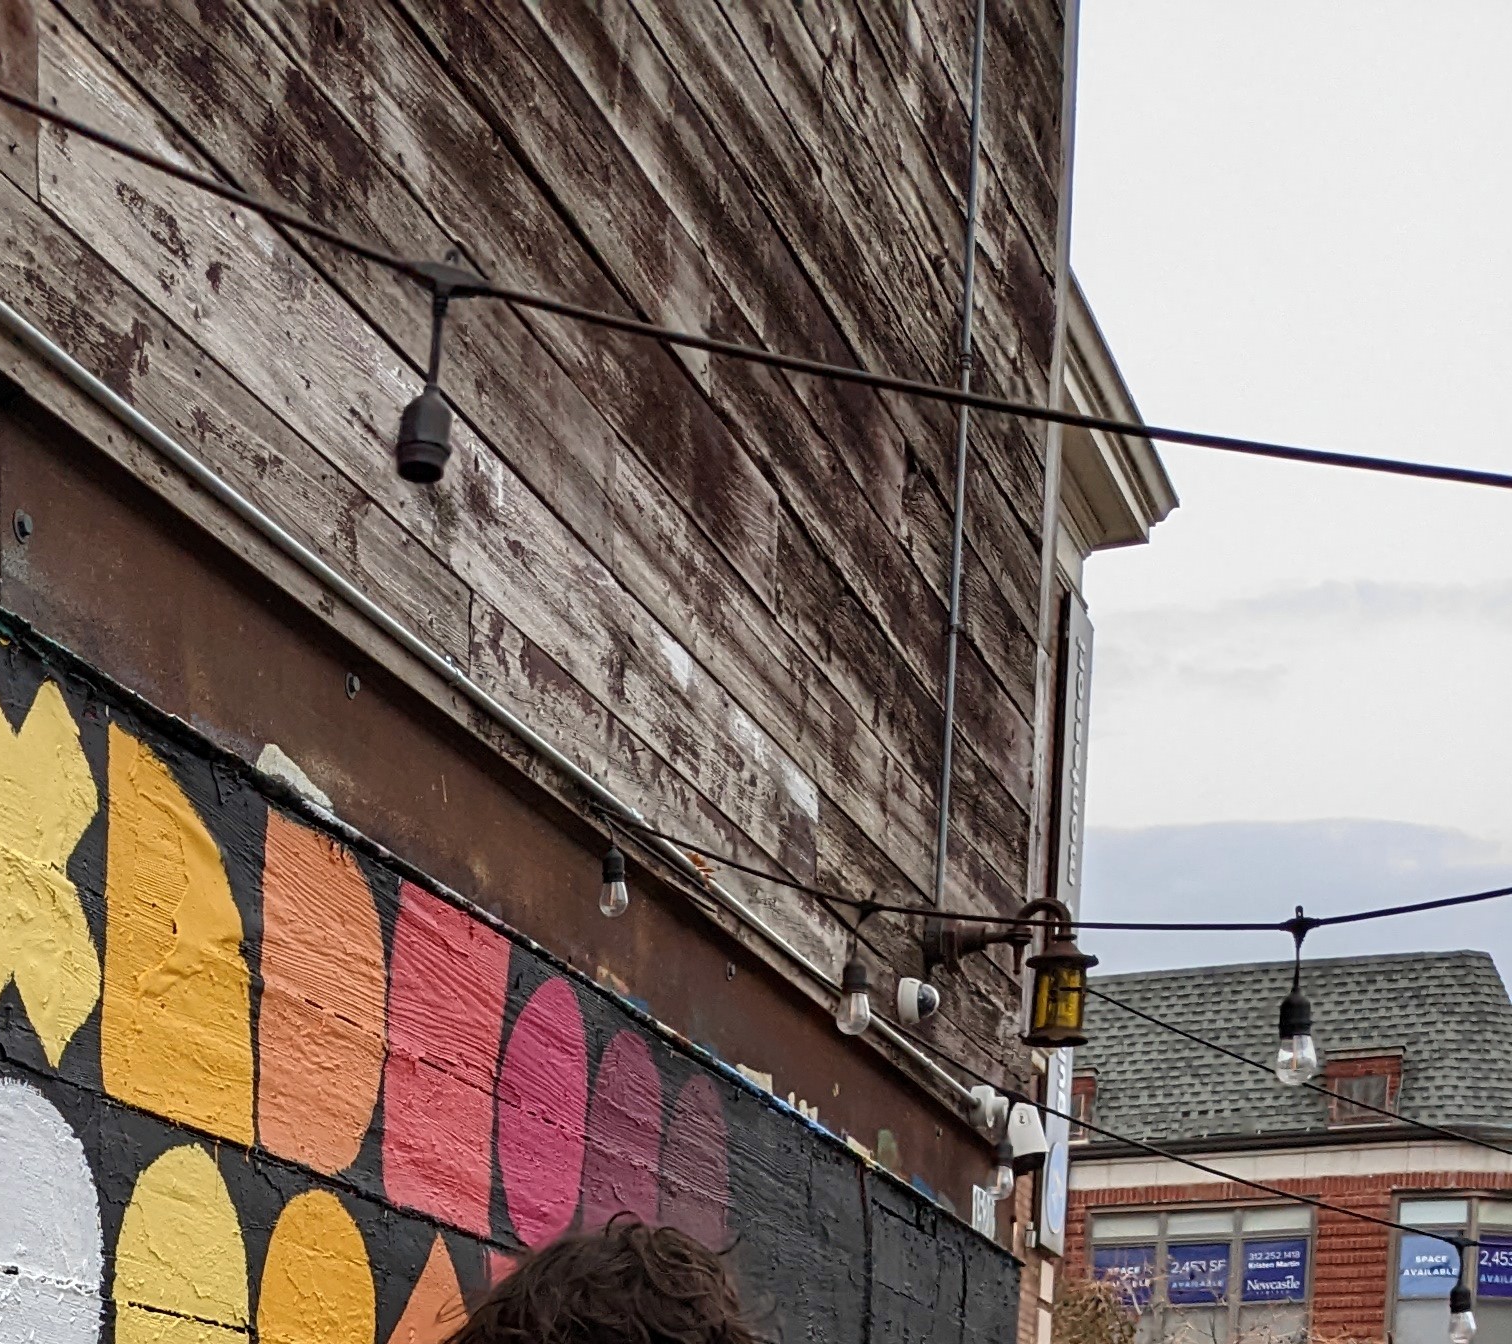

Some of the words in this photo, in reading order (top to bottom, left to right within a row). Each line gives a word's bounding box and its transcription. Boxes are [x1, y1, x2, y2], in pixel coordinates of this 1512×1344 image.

[1068, 636, 1086, 887] montessori
[1209, 1259, 1226, 1272] SF
[1415, 1255, 1448, 1263] SPACE
[1403, 1268, 1459, 1276] AVAILABLE
[1247, 1275, 1301, 1290] Newcastle
